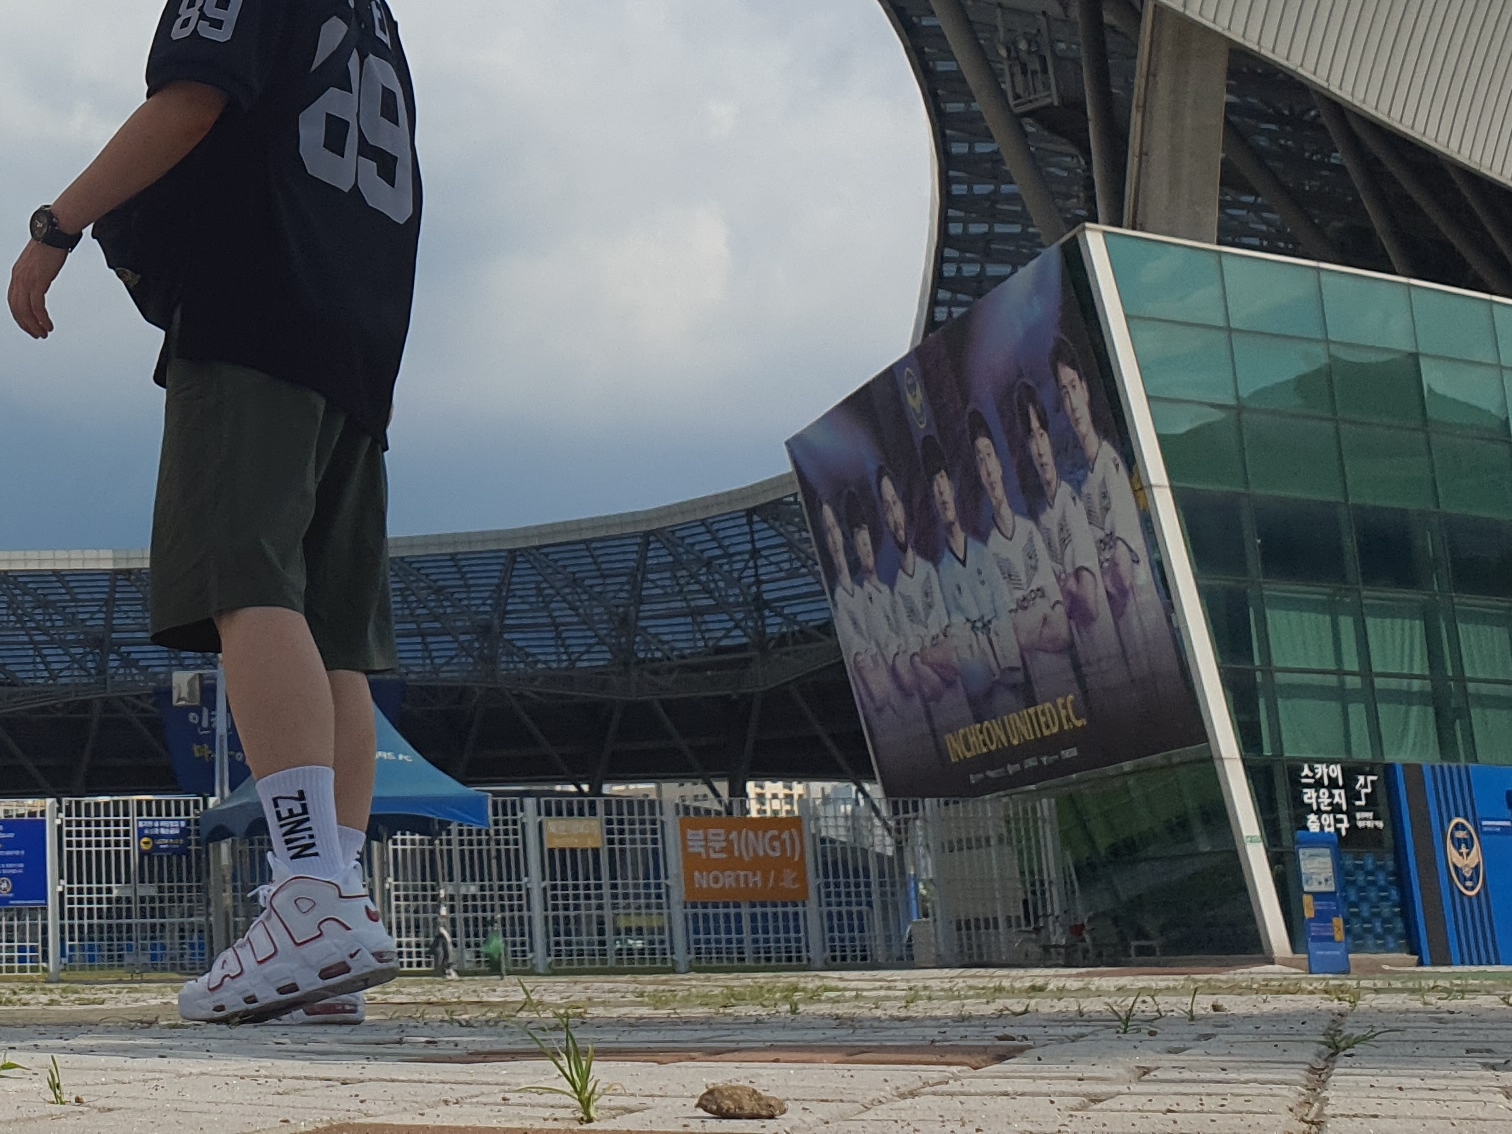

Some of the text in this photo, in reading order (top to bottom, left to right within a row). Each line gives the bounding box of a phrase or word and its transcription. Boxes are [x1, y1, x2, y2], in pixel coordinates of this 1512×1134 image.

[299, 16, 413, 225] 89
[945, 719, 1008, 762] INCHEON
[1006, 702, 1059, 745] UNITED
[1300, 763, 1344, 787] 스카이
[1303, 788, 1348, 811] 라운지
[1306, 812, 1350, 836] 출입구
[686, 827, 801, 862] 북문1(NG1)
[693, 869, 762, 889] NORTH
[780, 868, 800, 889] 北
